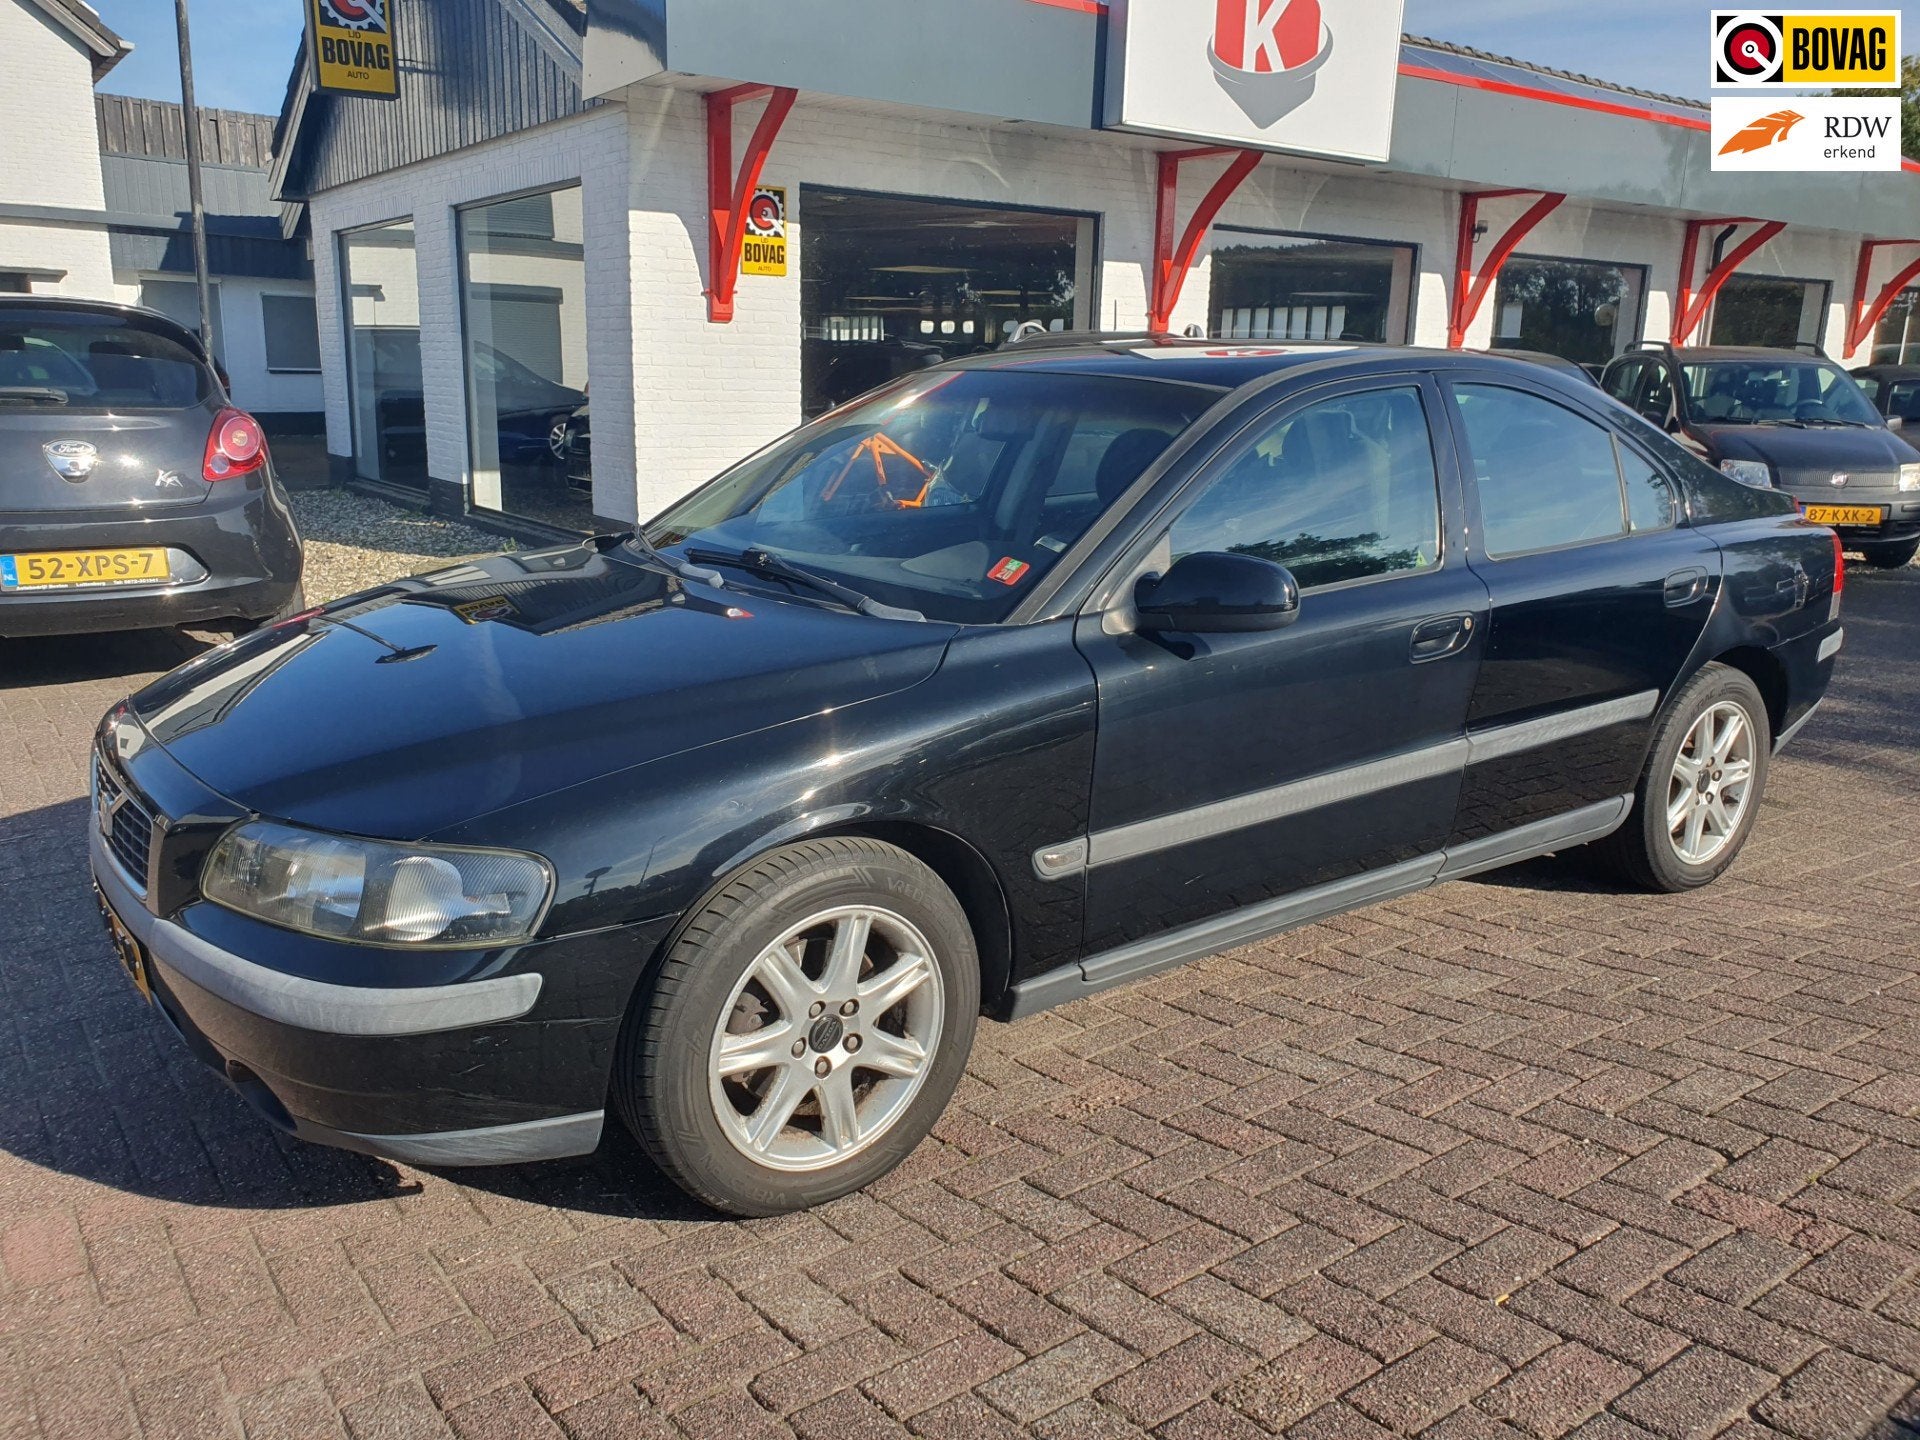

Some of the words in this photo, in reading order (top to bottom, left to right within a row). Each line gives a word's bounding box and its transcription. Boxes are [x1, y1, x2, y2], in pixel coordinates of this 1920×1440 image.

[1242, 0, 1293, 72] K
[321, 36, 391, 71] BOVAG
[347, 70, 370, 80] AUTO
[744, 242, 785, 265] BOVAG
[154, 469, 183, 488] Ka
[1808, 508, 1875, 522] 87-KXK-2
[28, 552, 154, 580] 52-XPS-7
[3, 573, 16, 581] NL
